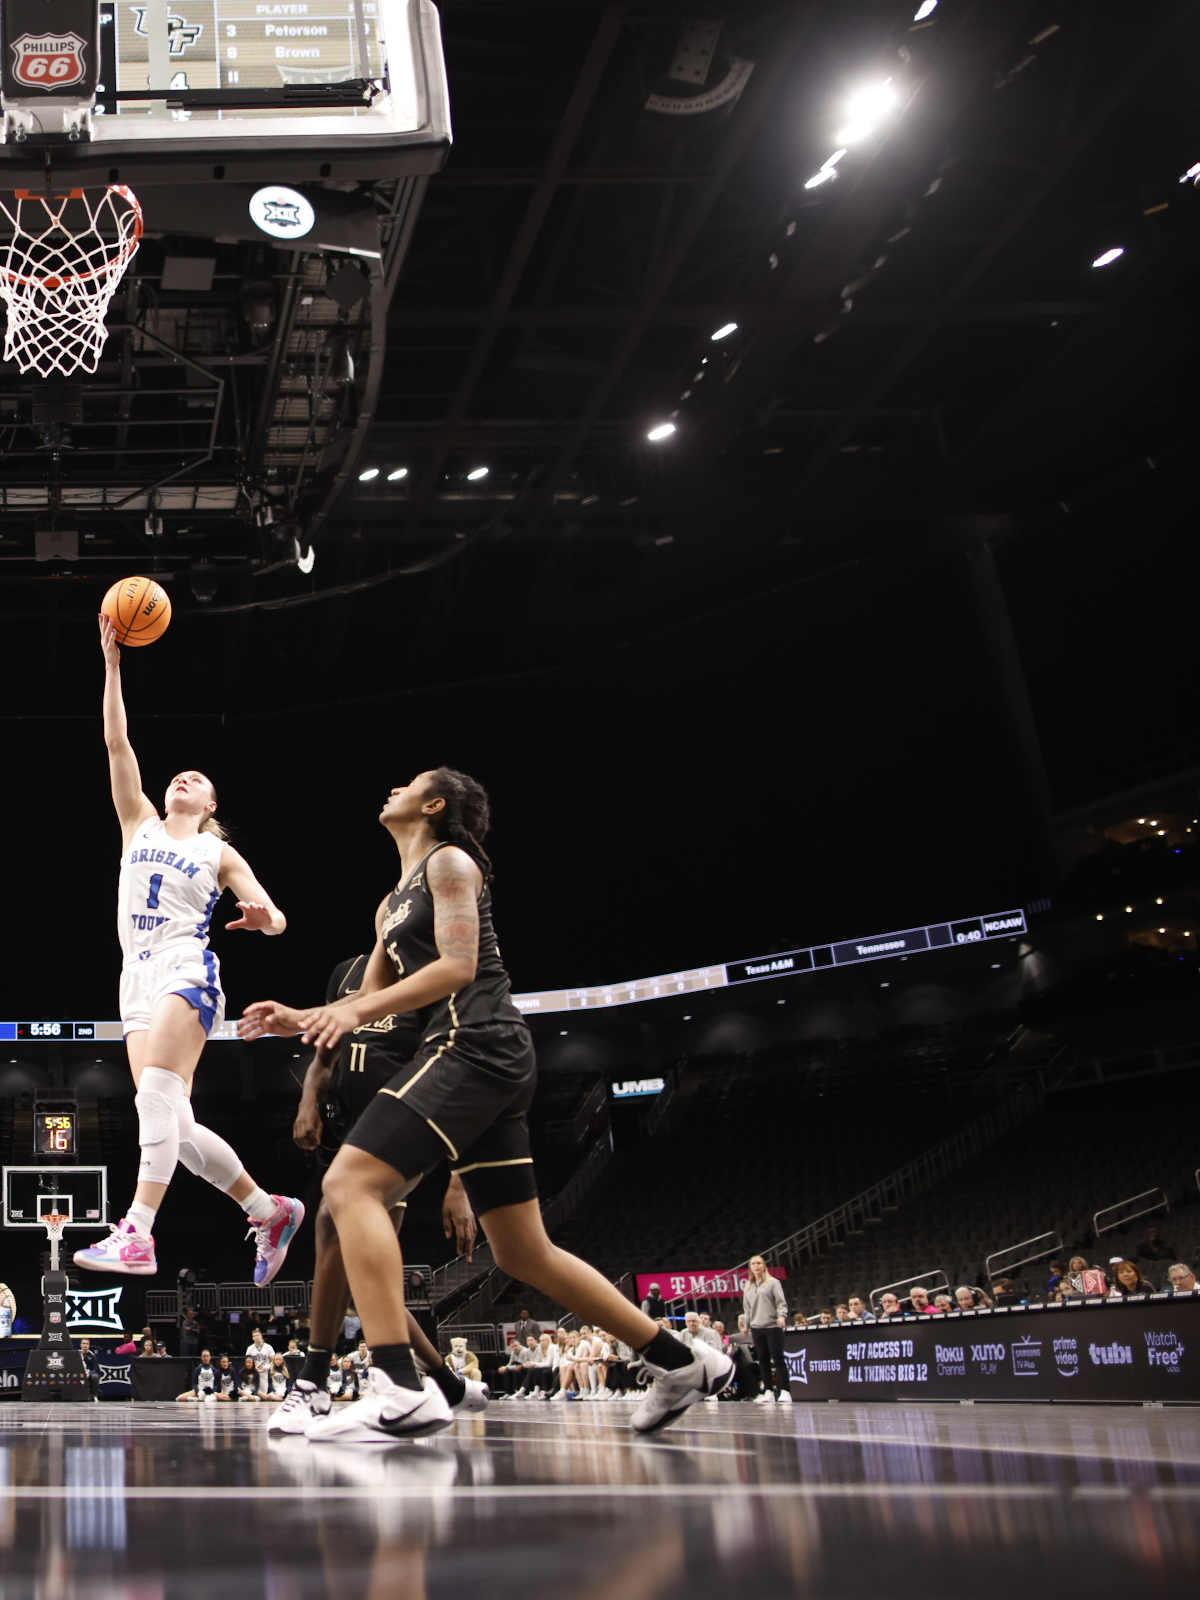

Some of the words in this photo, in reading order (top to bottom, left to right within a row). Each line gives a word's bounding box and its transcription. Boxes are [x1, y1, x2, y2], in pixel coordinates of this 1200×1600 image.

[256, 4, 308, 14] PLAYER
[226, 25, 237, 37] 3
[265, 24, 327, 36] Peterson
[23, 41, 75, 52] PHILLIPS
[275, 46, 320, 58] Brown
[26, 57, 71, 78] 66
[131, 848, 201, 879] BRIGHAM
[147, 873, 163, 909] 1
[131, 914, 171, 931] YOUN
[745, 964, 770, 976] Texas
[770, 958, 793, 971] A&M
[856, 939, 905, 956] Tennessee
[957, 930, 981, 943] 0:40
[984, 916, 1022, 932] NCAAW
[30, 1023, 61, 1036] 5:56
[350, 1042, 367, 1073] 11
[612, 1078, 665, 1094] UMB
[50, 1130, 67, 1150] 16
[1053, 1336, 1077, 1352] prime
[1144, 1331, 1177, 1346] Watch
[846, 1342, 866, 1360] 24/7
[867, 1341, 900, 1359] ACCESS
[901, 1340, 913, 1357] TO
[970, 1343, 1005, 1361] xumo
[1015, 1349, 1041, 1357] SAMSUNG
[1088, 1342, 1133, 1365] tubi
[809, 1359, 841, 1372] STUDIOS
[1055, 1352, 1078, 1365] video
[848, 1366, 862, 1382] ALL
[864, 1365, 897, 1382] THINGS
[898, 1364, 914, 1382] BIG
[916, 1364, 928, 1381] 12
[937, 1363, 965, 1376] Channel
[981, 1363, 997, 1375] PLAY
